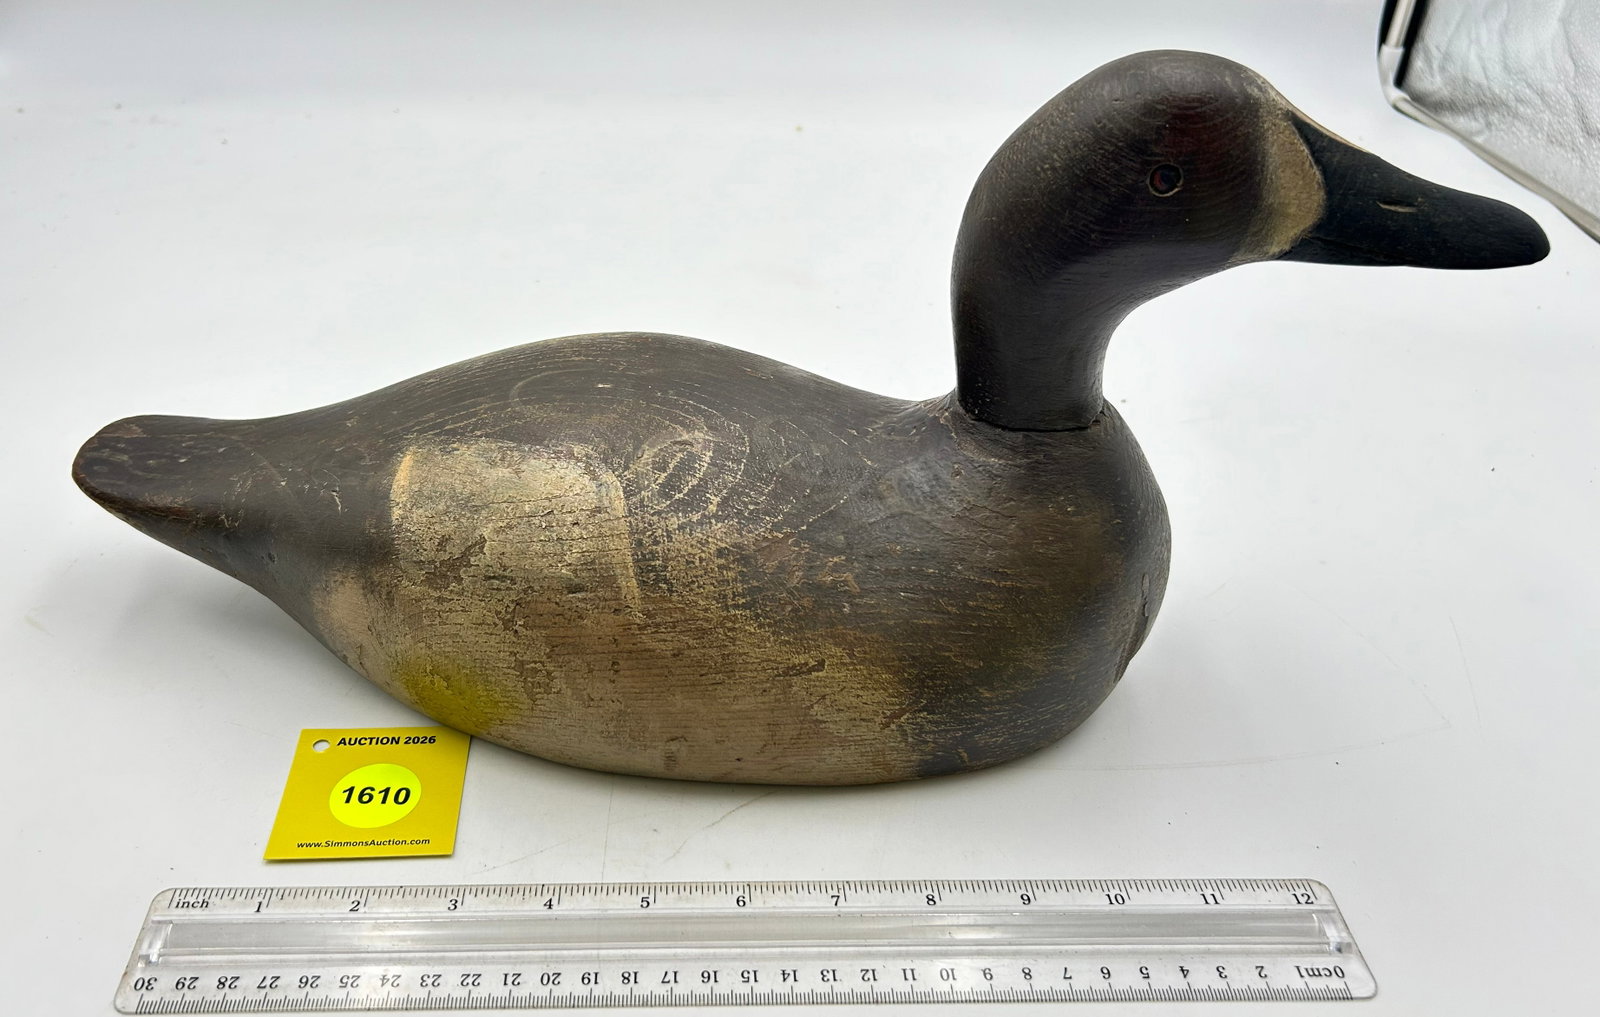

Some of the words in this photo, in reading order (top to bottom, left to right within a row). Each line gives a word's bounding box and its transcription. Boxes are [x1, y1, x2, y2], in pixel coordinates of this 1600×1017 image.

[337, 736, 400, 746] AUCTION
[403, 736, 436, 744] 2026
[342, 786, 411, 805] 1610
[297, 838, 430, 848] www.SimmonsAuction.com
[175, 899, 209, 908] inch
[254, 901, 262, 912] 1
[349, 900, 361, 912] 2
[448, 899, 458, 911] 3
[543, 898, 554, 909] 4
[640, 897, 650, 908] 5
[736, 896, 746, 908] 6
[830, 895, 840, 906] 7
[926, 894, 937, 906] 8
[1020, 894, 1031, 905] 9
[1105, 893, 1126, 905] 10
[1200, 893, 1220, 905] 11
[1292, 893, 1314, 905] 12
[581, 972, 600, 985] 19
[621, 971, 639, 984] 18
[661, 971, 679, 984] 17
[701, 970, 719, 984] 16
[741, 970, 759, 983] 15
[780, 969, 799, 983] 14
[820, 969, 837, 982] 13
[860, 969, 878, 981] 12
[901, 968, 917, 981] 11
[940, 968, 957, 981] 10
[982, 968, 994, 981] 9
[1022, 967, 1032, 980] 8
[1063, 967, 1072, 980] 7
[1100, 966, 1111, 979] 6
[1139, 966, 1150, 979] 5
[1179, 966, 1190, 979] 4
[1216, 966, 1228, 979] 3
[1255, 966, 1268, 978] 2
[134, 977, 157, 991] 30
[176, 976, 199, 990] 29
[217, 976, 240, 990] 28
[257, 976, 281, 989] 27
[298, 975, 321, 989] 26
[339, 975, 361, 988] 25
[380, 974, 401, 988] 24
[420, 974, 442, 987] 23
[460, 973, 482, 986] 22
[502, 973, 522, 986] 21
[540, 972, 562, 986] 20
